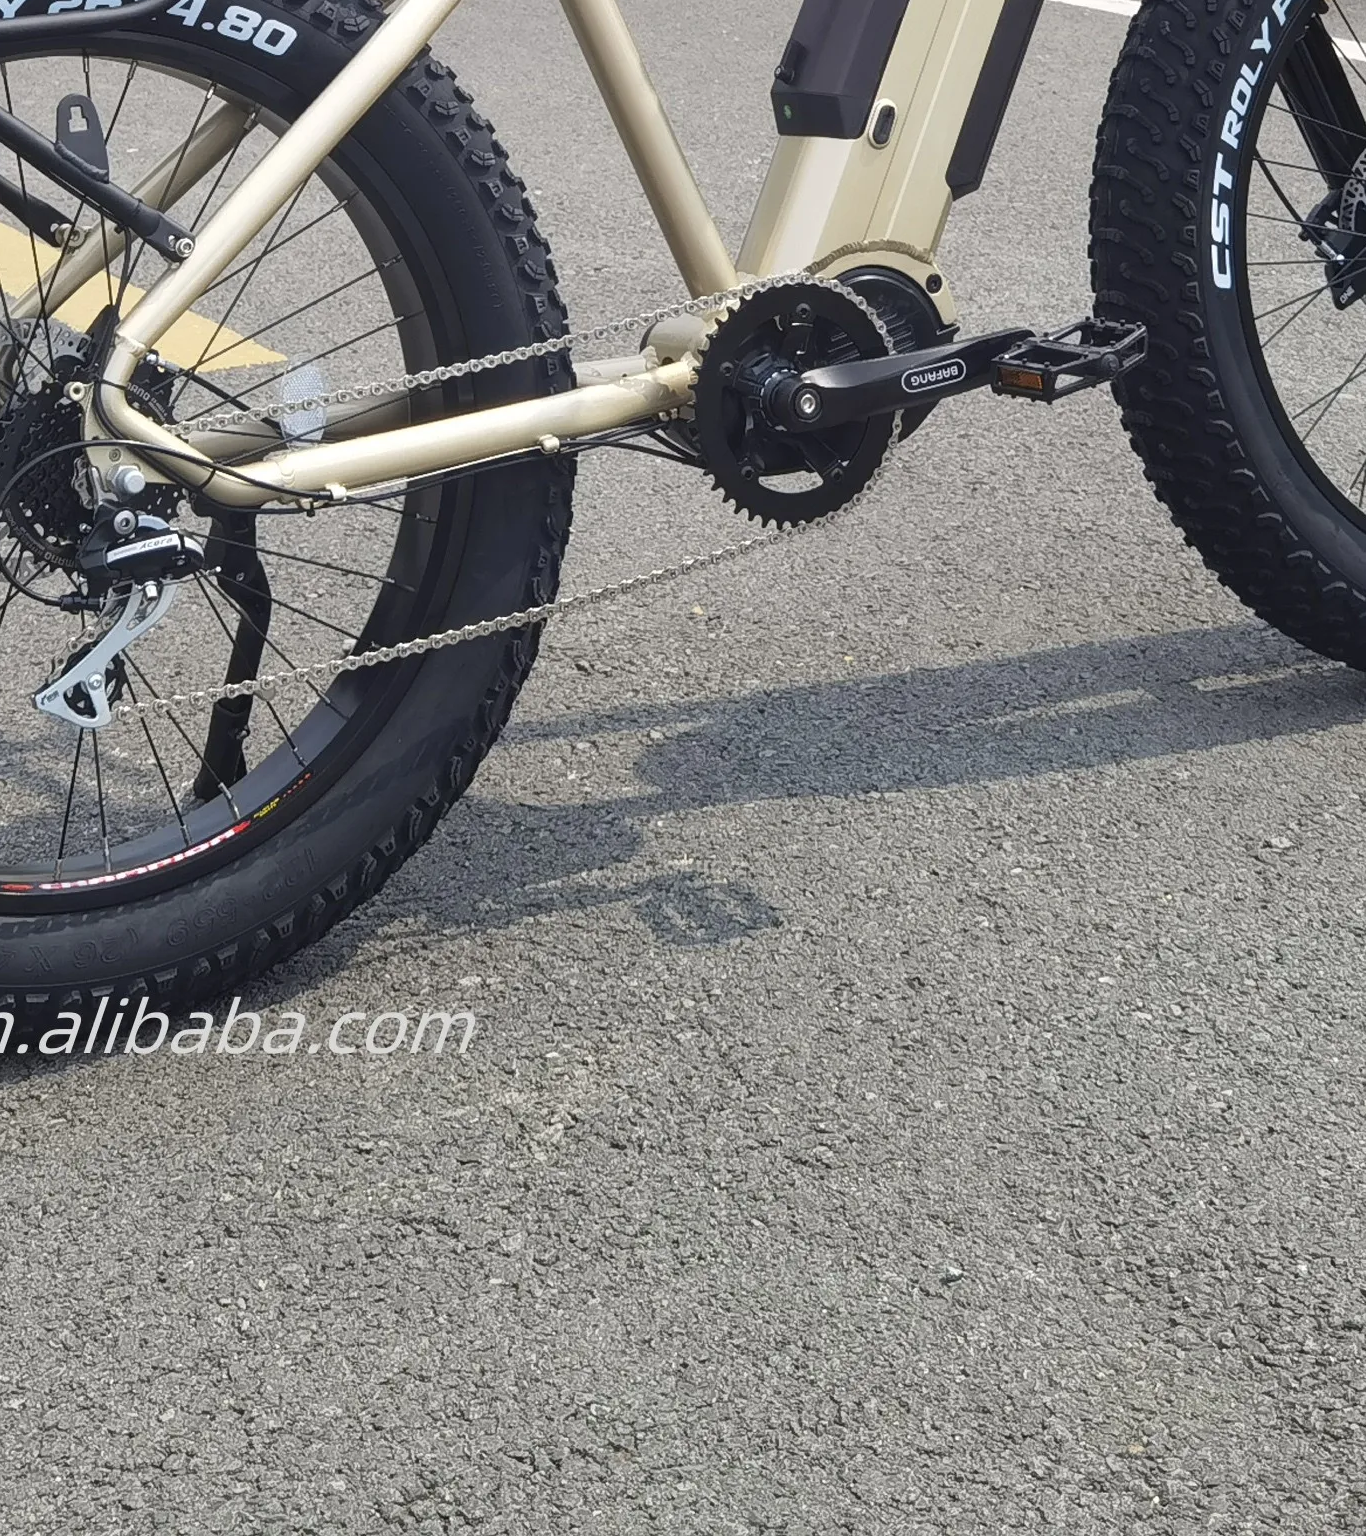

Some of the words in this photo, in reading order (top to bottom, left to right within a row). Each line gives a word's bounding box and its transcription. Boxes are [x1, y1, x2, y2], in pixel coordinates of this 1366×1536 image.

[1220, 16, 1272, 150] ROLY
[1210, 151, 1233, 290] CST
[910, 365, 959, 386] BAFANG
